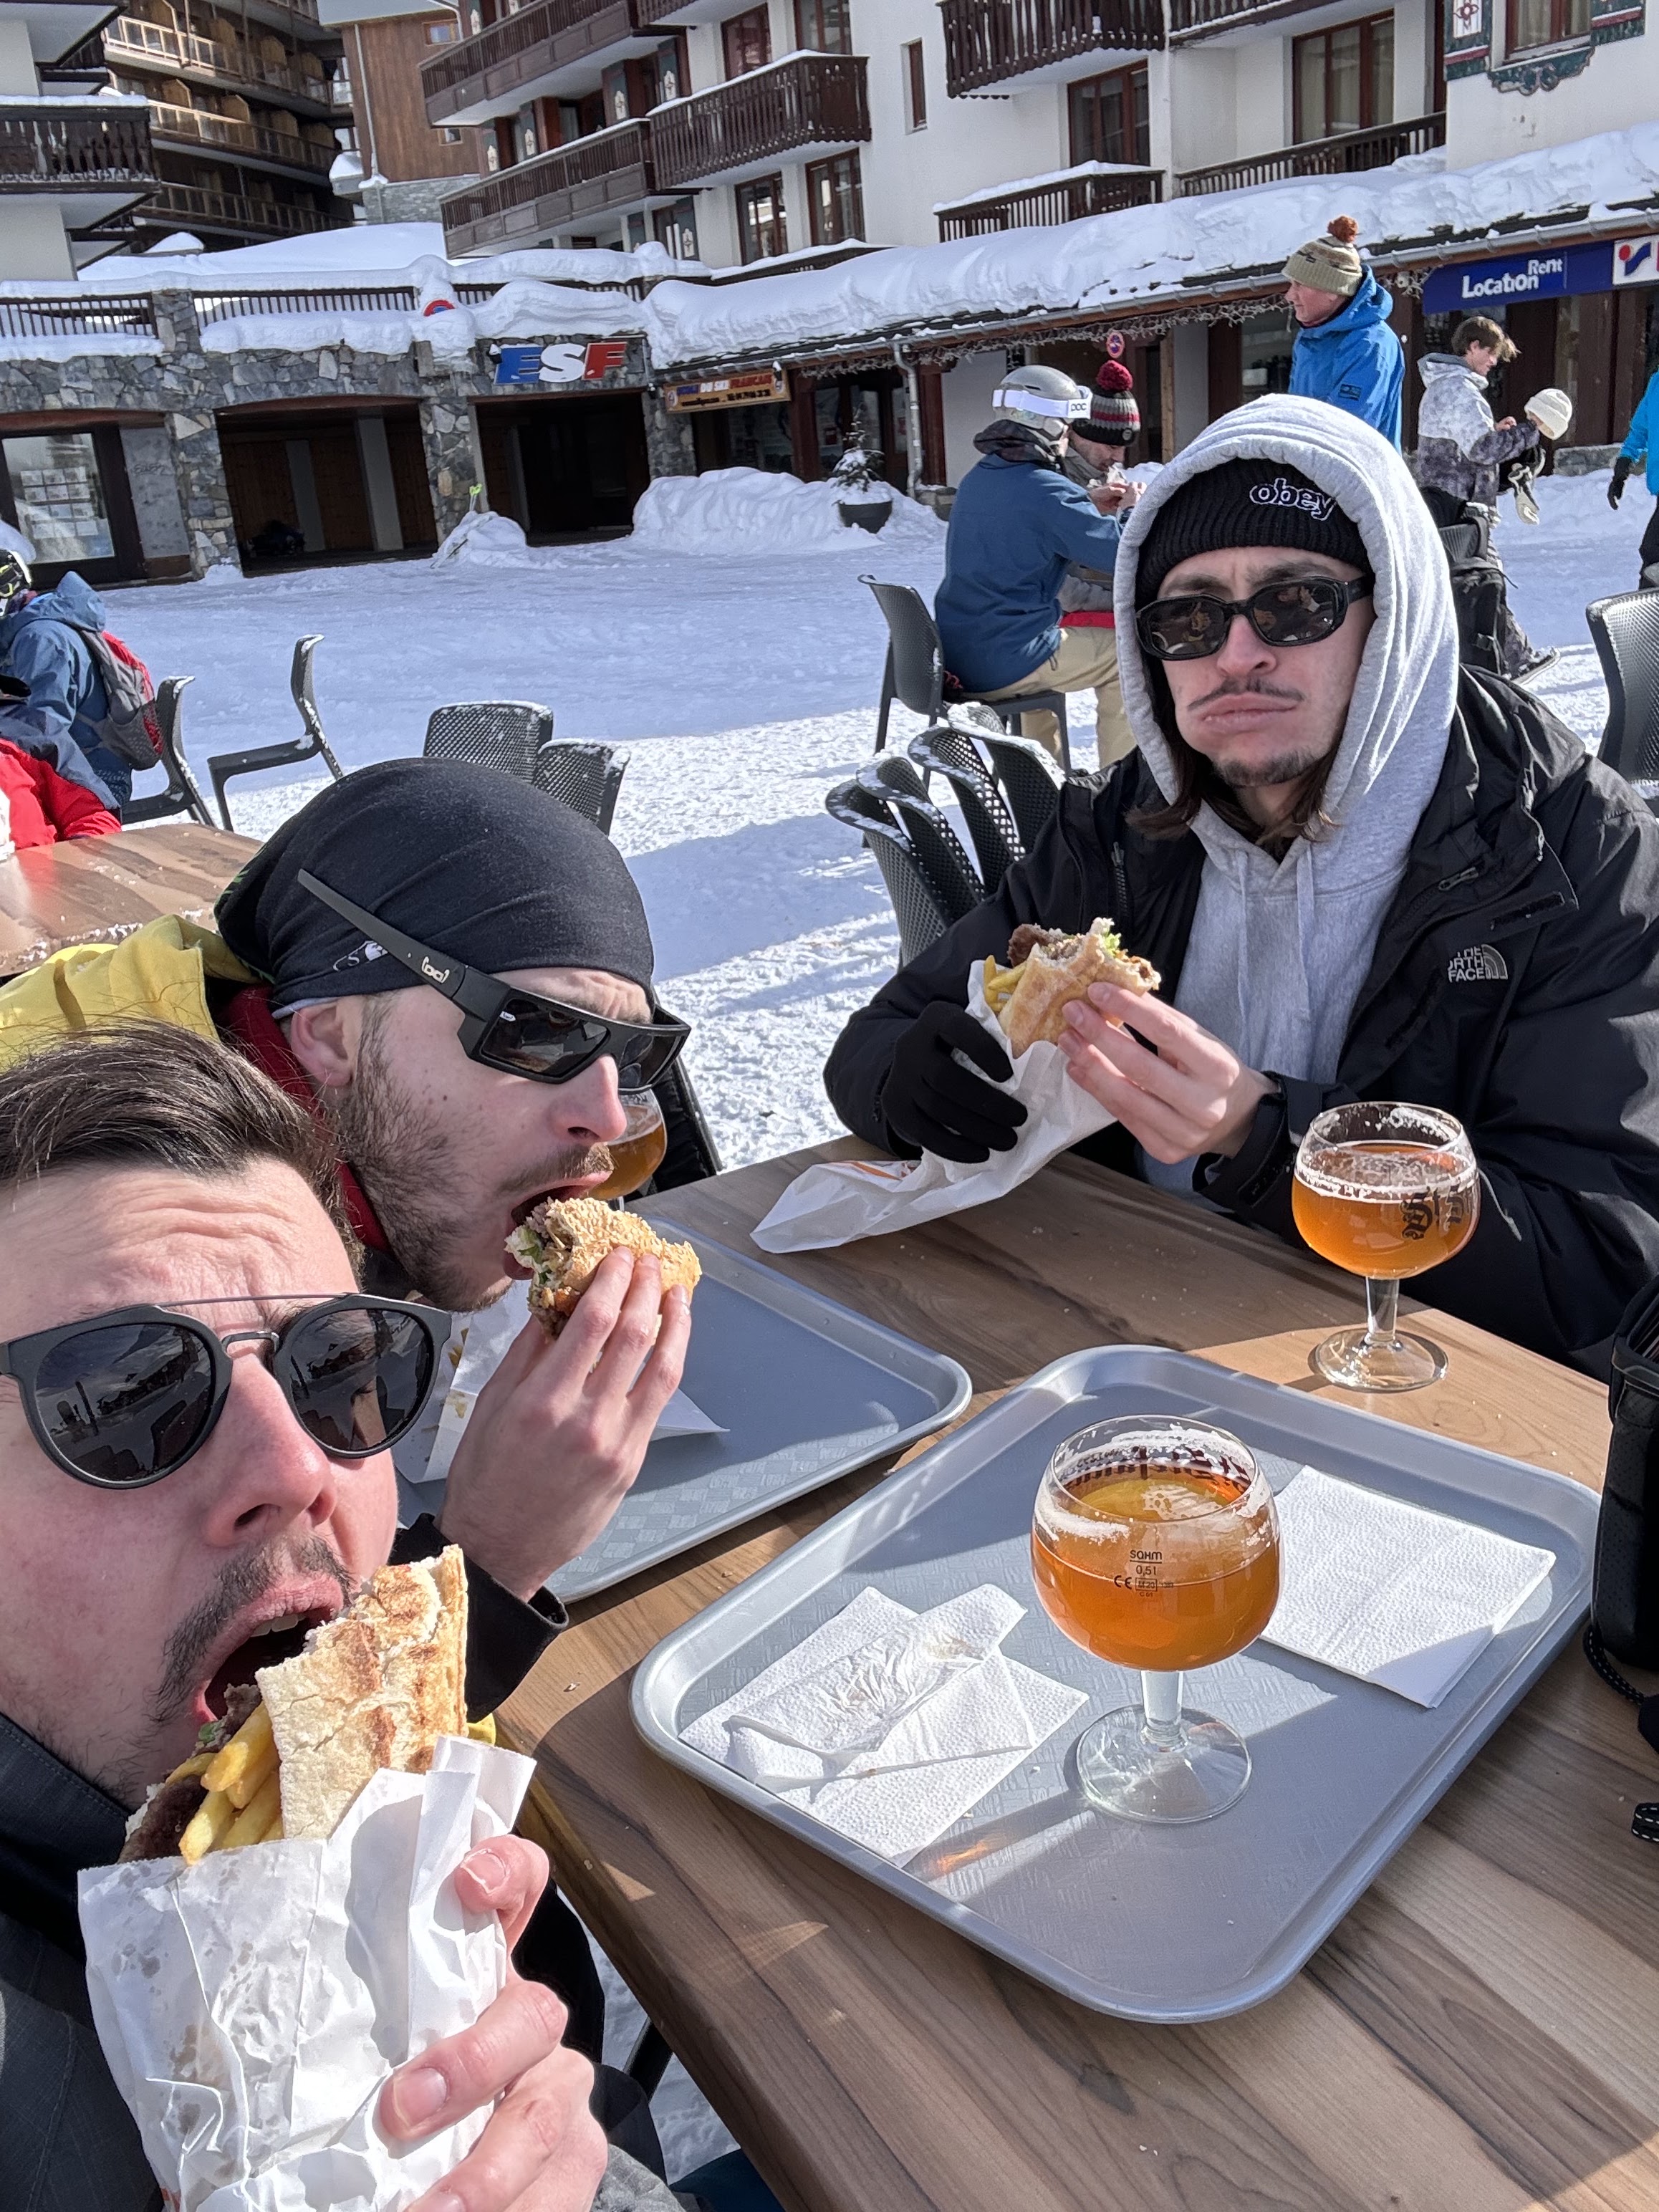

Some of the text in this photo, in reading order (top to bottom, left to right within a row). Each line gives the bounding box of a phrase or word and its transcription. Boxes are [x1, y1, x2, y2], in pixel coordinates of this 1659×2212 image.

[1461, 258, 1563, 299] Location Rent
[494, 342, 628, 385] ESF
[1070, 403, 1087, 412] POC
[1249, 477, 1338, 521] obey
[1448, 956, 1484, 971] RTH
[1448, 968, 1486, 983] FACE
